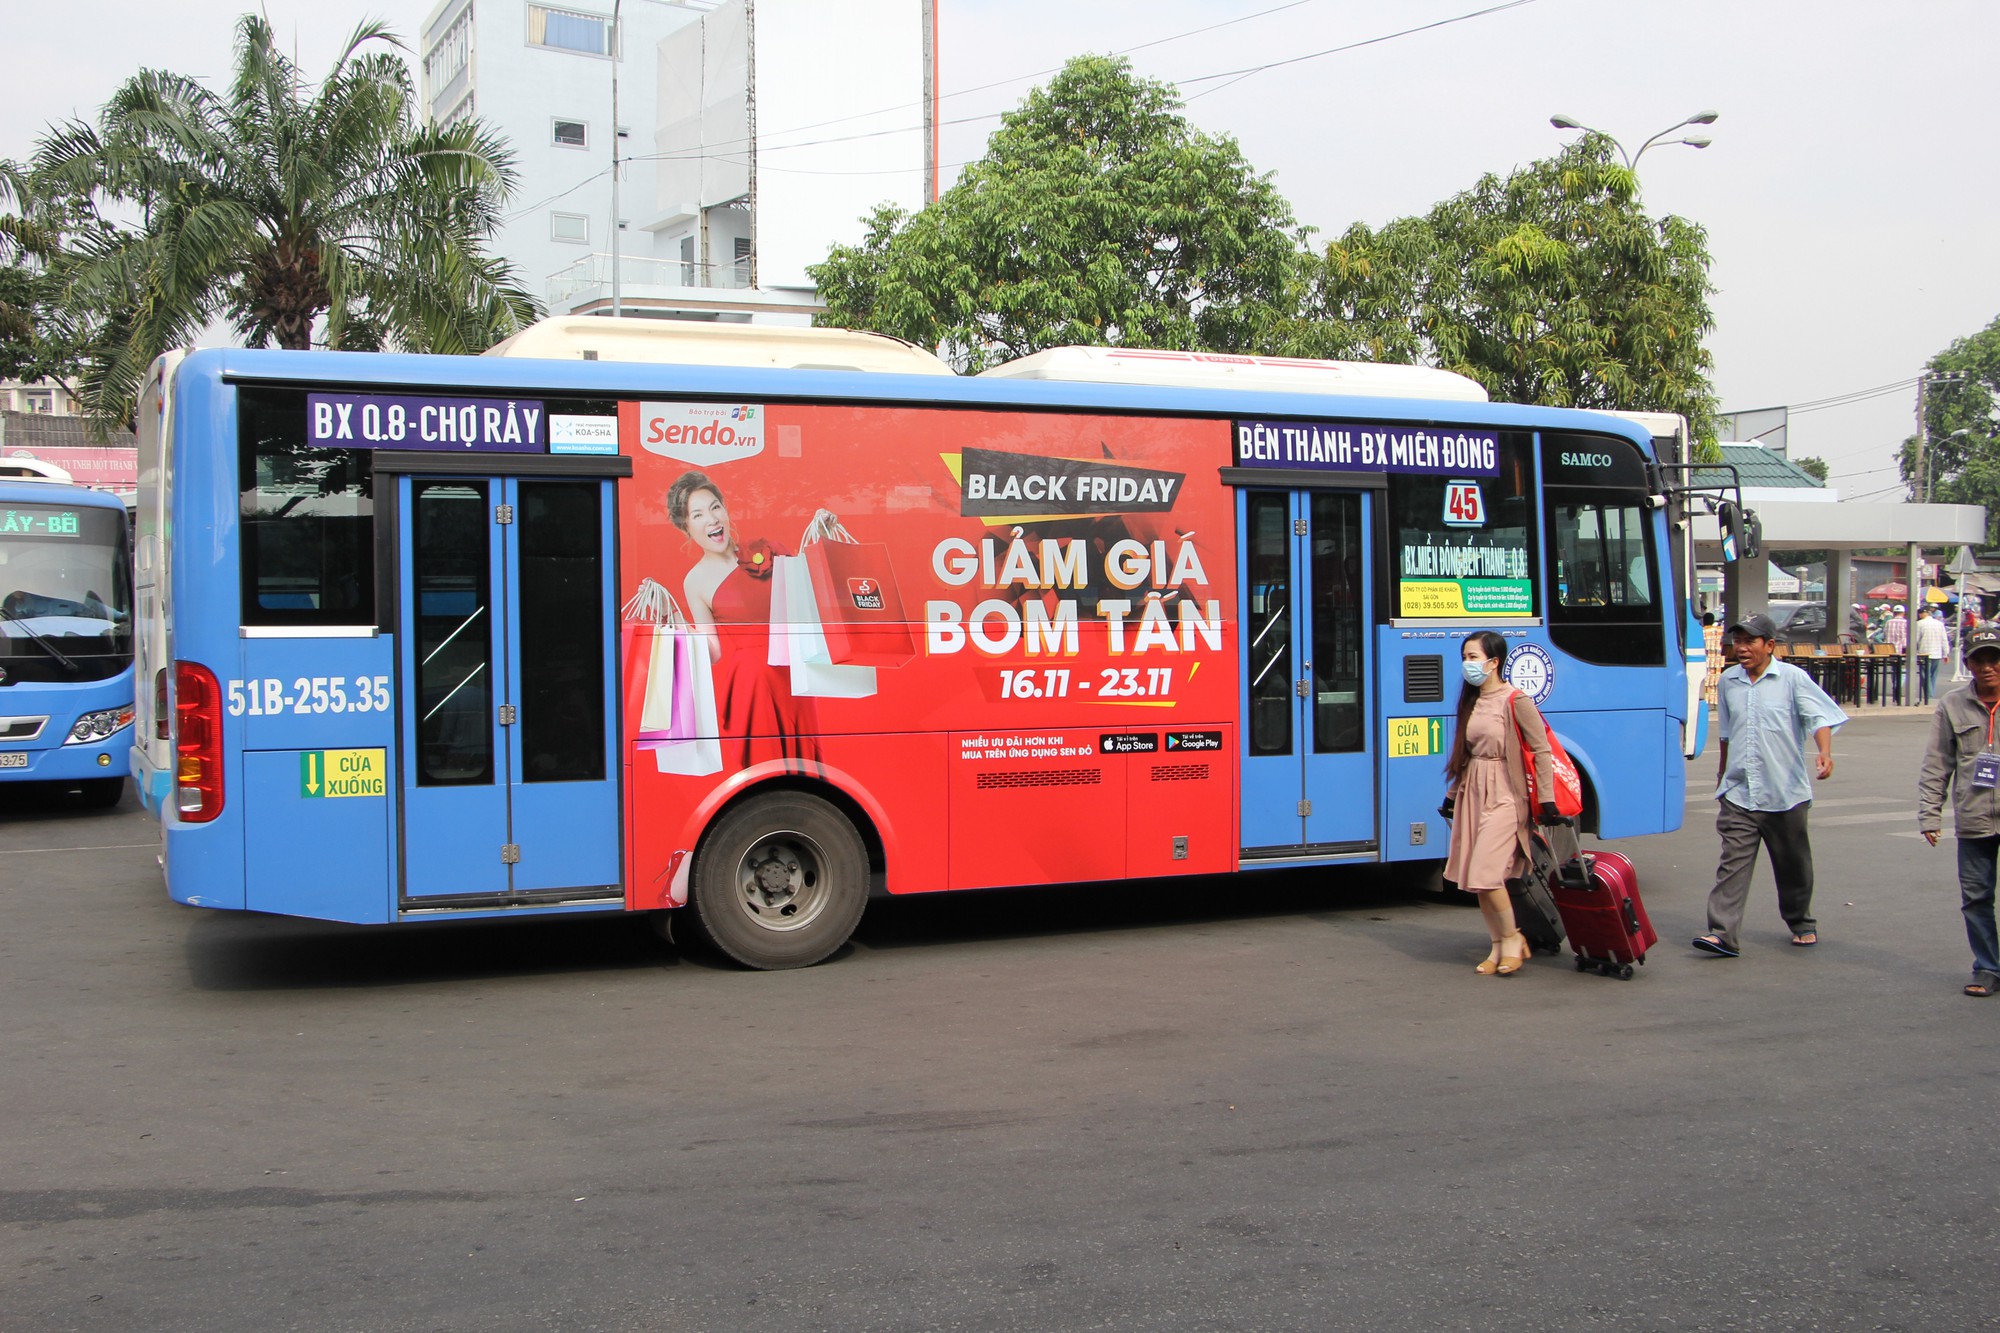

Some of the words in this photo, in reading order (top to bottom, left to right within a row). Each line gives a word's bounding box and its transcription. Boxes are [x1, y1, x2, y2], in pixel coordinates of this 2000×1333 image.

[731, 405, 755, 422] FPT
[314, 402, 354, 440] BX
[483, 401, 540, 444] RẪY
[575, 428, 612, 437] KOA-SHA
[647, 417, 757, 447] Sendo.vn
[1441, 433, 1496, 470] ĐÔNG
[1561, 452, 1612, 467] SAMCO
[63, 459, 72, 469] TY
[967, 474, 1068, 501] BLACK
[1076, 476, 1176, 503] FRIDAY
[1449, 486, 1479, 521] 45
[931, 526, 1089, 588] GIẢM
[1105, 531, 1209, 588] GIÁ
[1404, 601, 1422, 610] (028)
[1423, 601, 1459, 609] 39.505.505
[924, 598, 1079, 657] BOM
[1097, 590, 1222, 655] TẤN
[1401, 631, 1446, 639] SAMCO
[1973, 633, 1996, 642] FILA
[1000, 669, 1070, 698] 16.11
[1097, 668, 1172, 696] 23.11
[1520, 679, 1538, 690] 51N
[228, 675, 390, 716] 51B-255.35
[1397, 720, 1419, 737] CỬA
[1005, 735, 1023, 746] ĐÃI
[1024, 736, 1046, 745] HƠN
[1047, 736, 1064, 745] KHI
[1116, 741, 1132, 751] App
[1132, 741, 1154, 750] Store
[1182, 740, 1205, 749] Google
[1205, 739, 1219, 748] Play
[1397, 739, 1419, 755] LÊN
[961, 750, 982, 760] MUA
[984, 748, 1006, 758] TRÊN
[1008, 747, 1029, 758] ỨNG
[1031, 748, 1058, 759] DỤNG
[1060, 747, 1076, 756] SEN
[1078, 744, 1093, 755] ĐỎ
[339, 752, 372, 772] CỬA
[328, 774, 383, 795] XUỐNG
